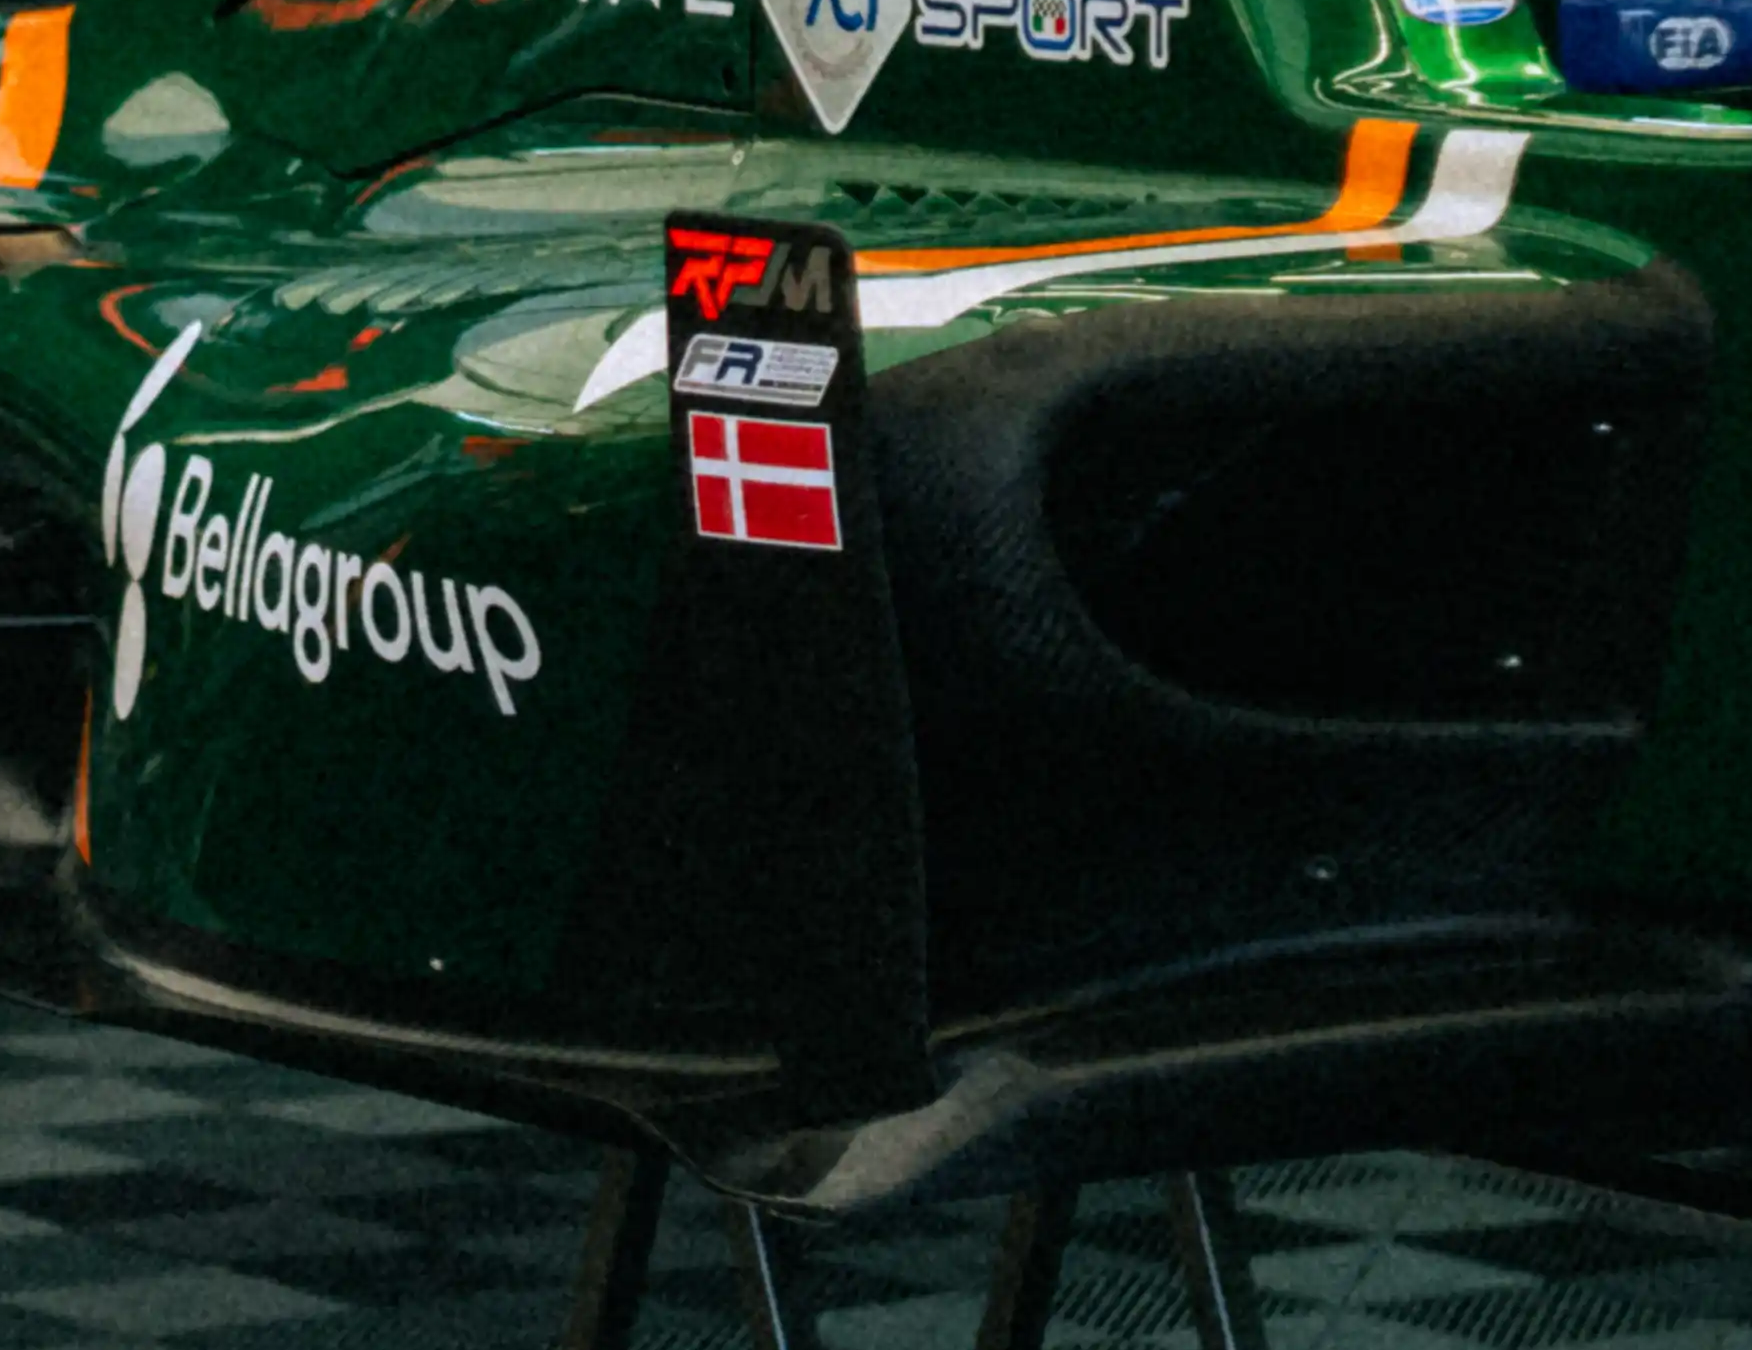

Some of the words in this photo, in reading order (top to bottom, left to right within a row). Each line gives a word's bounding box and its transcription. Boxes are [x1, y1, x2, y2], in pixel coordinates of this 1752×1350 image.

[1655, 25, 1724, 61] FIA
[668, 227, 834, 322] RPM
[161, 454, 542, 716] Bellagroup
